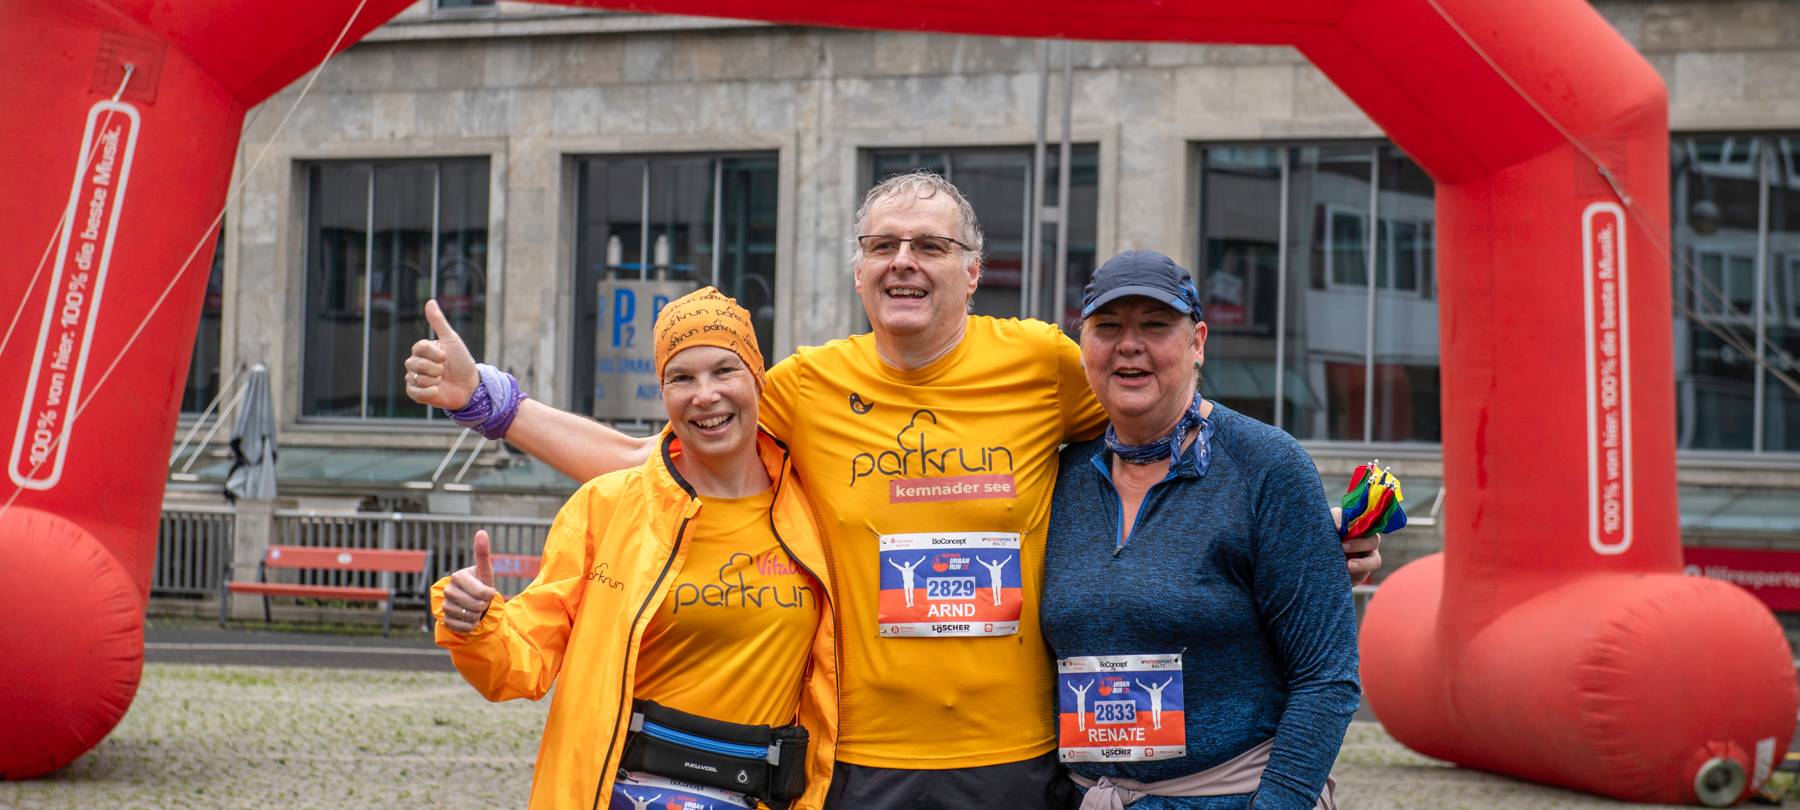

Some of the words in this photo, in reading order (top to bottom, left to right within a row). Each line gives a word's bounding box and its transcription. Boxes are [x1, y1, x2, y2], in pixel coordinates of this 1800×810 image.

[93, 124, 122, 186] Musik.
[80, 187, 108, 241] beste
[75, 242, 95, 270] die
[61, 271, 89, 328] 100%
[1600, 280, 1616, 330] beste
[51, 330, 76, 371] hier.
[1600, 330, 1616, 357] die
[47, 373, 65, 406] von
[1601, 357, 1617, 410] 100%
[29, 409, 58, 466] 100%
[851, 409, 1013, 487] parkrun
[1606, 448, 1619, 481] von
[895, 482, 979, 497] kemnader
[984, 482, 1011, 493] see
[1604, 481, 1620, 535] 100%
[932, 538, 967, 546] BoConcept
[586, 562, 625, 592] arkrun
[672, 552, 817, 615] parkrun
[928, 580, 975, 597] 2829
[927, 603, 976, 618] ARND
[1095, 703, 1135, 721] 2833
[1088, 727, 1146, 743] RENATE
